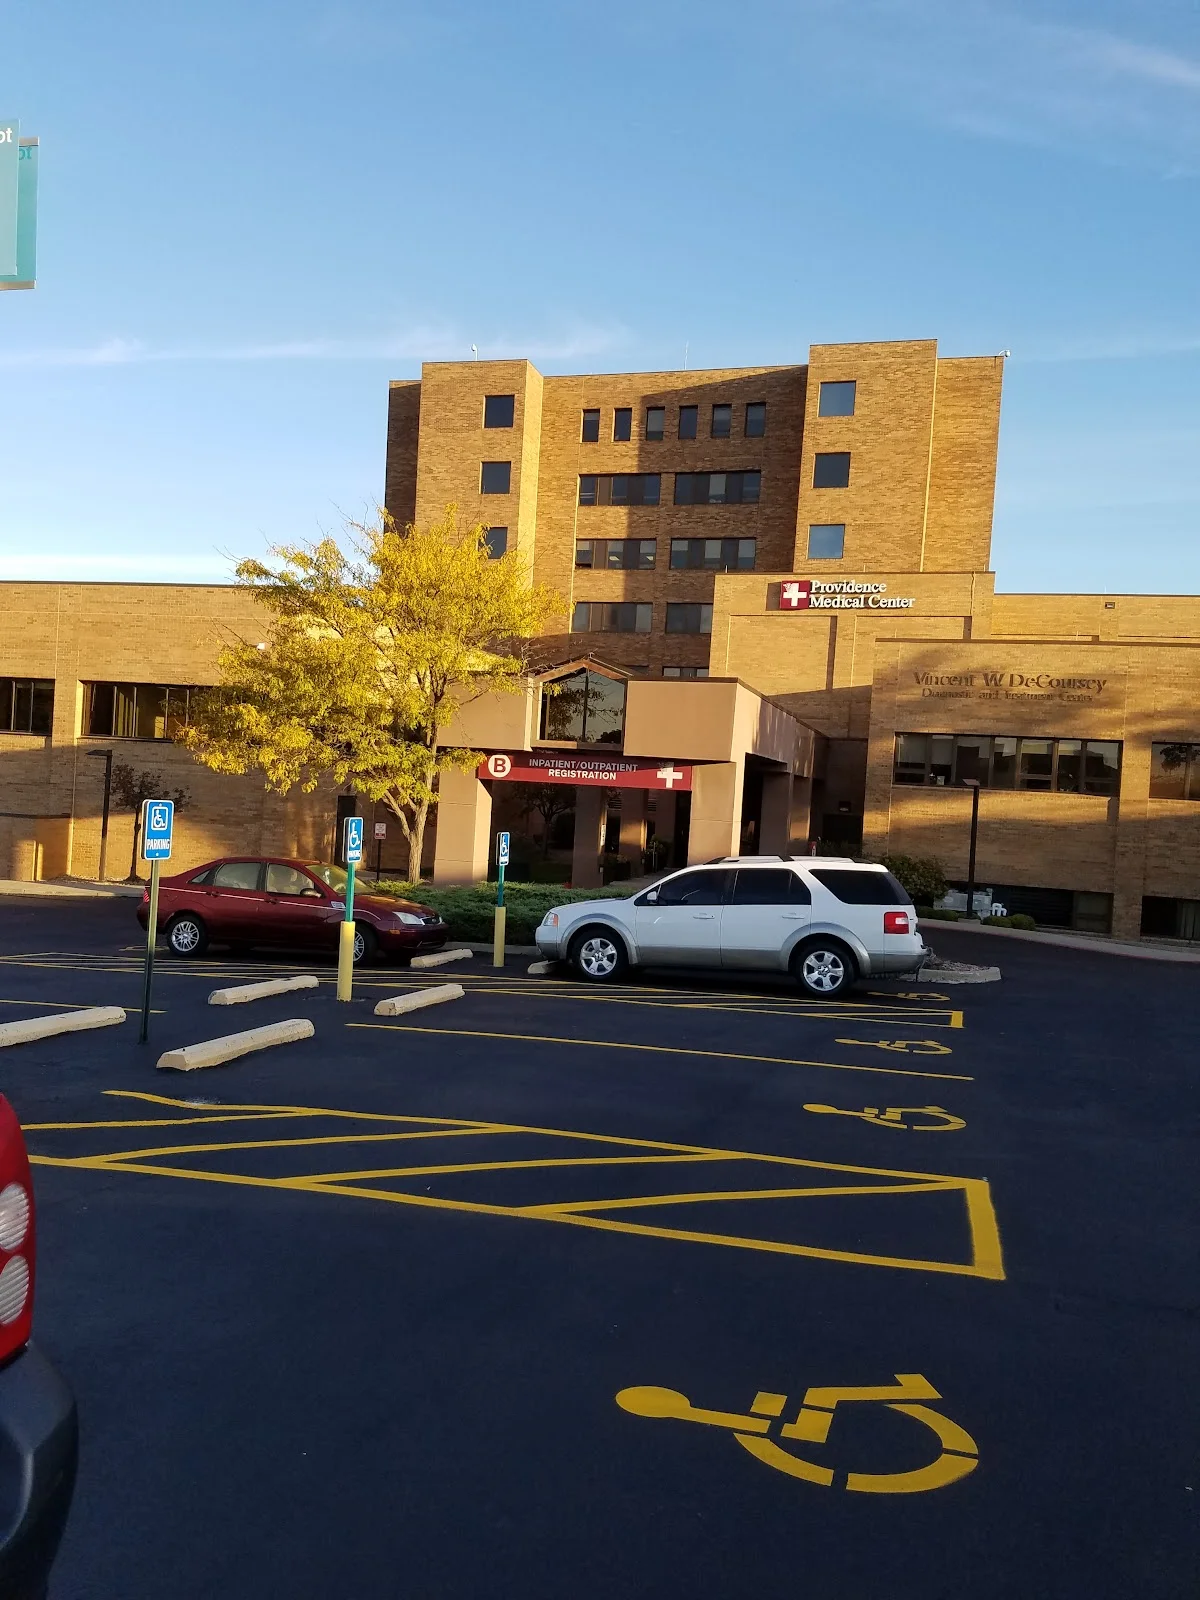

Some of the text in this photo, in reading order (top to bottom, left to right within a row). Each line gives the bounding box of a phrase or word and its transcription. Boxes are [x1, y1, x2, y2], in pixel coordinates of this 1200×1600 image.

[810, 580, 887, 593] Providence
[809, 594, 916, 608] Medical Center
[913, 671, 976, 686] Vincent
[1008, 673, 1107, 694] DeCoursey
[493, 757, 507, 773] B
[529, 758, 638, 772] INPATIENT/OUTPATIENT
[548, 768, 617, 781] REGISTRATION
[146, 838, 170, 850] PARKING
